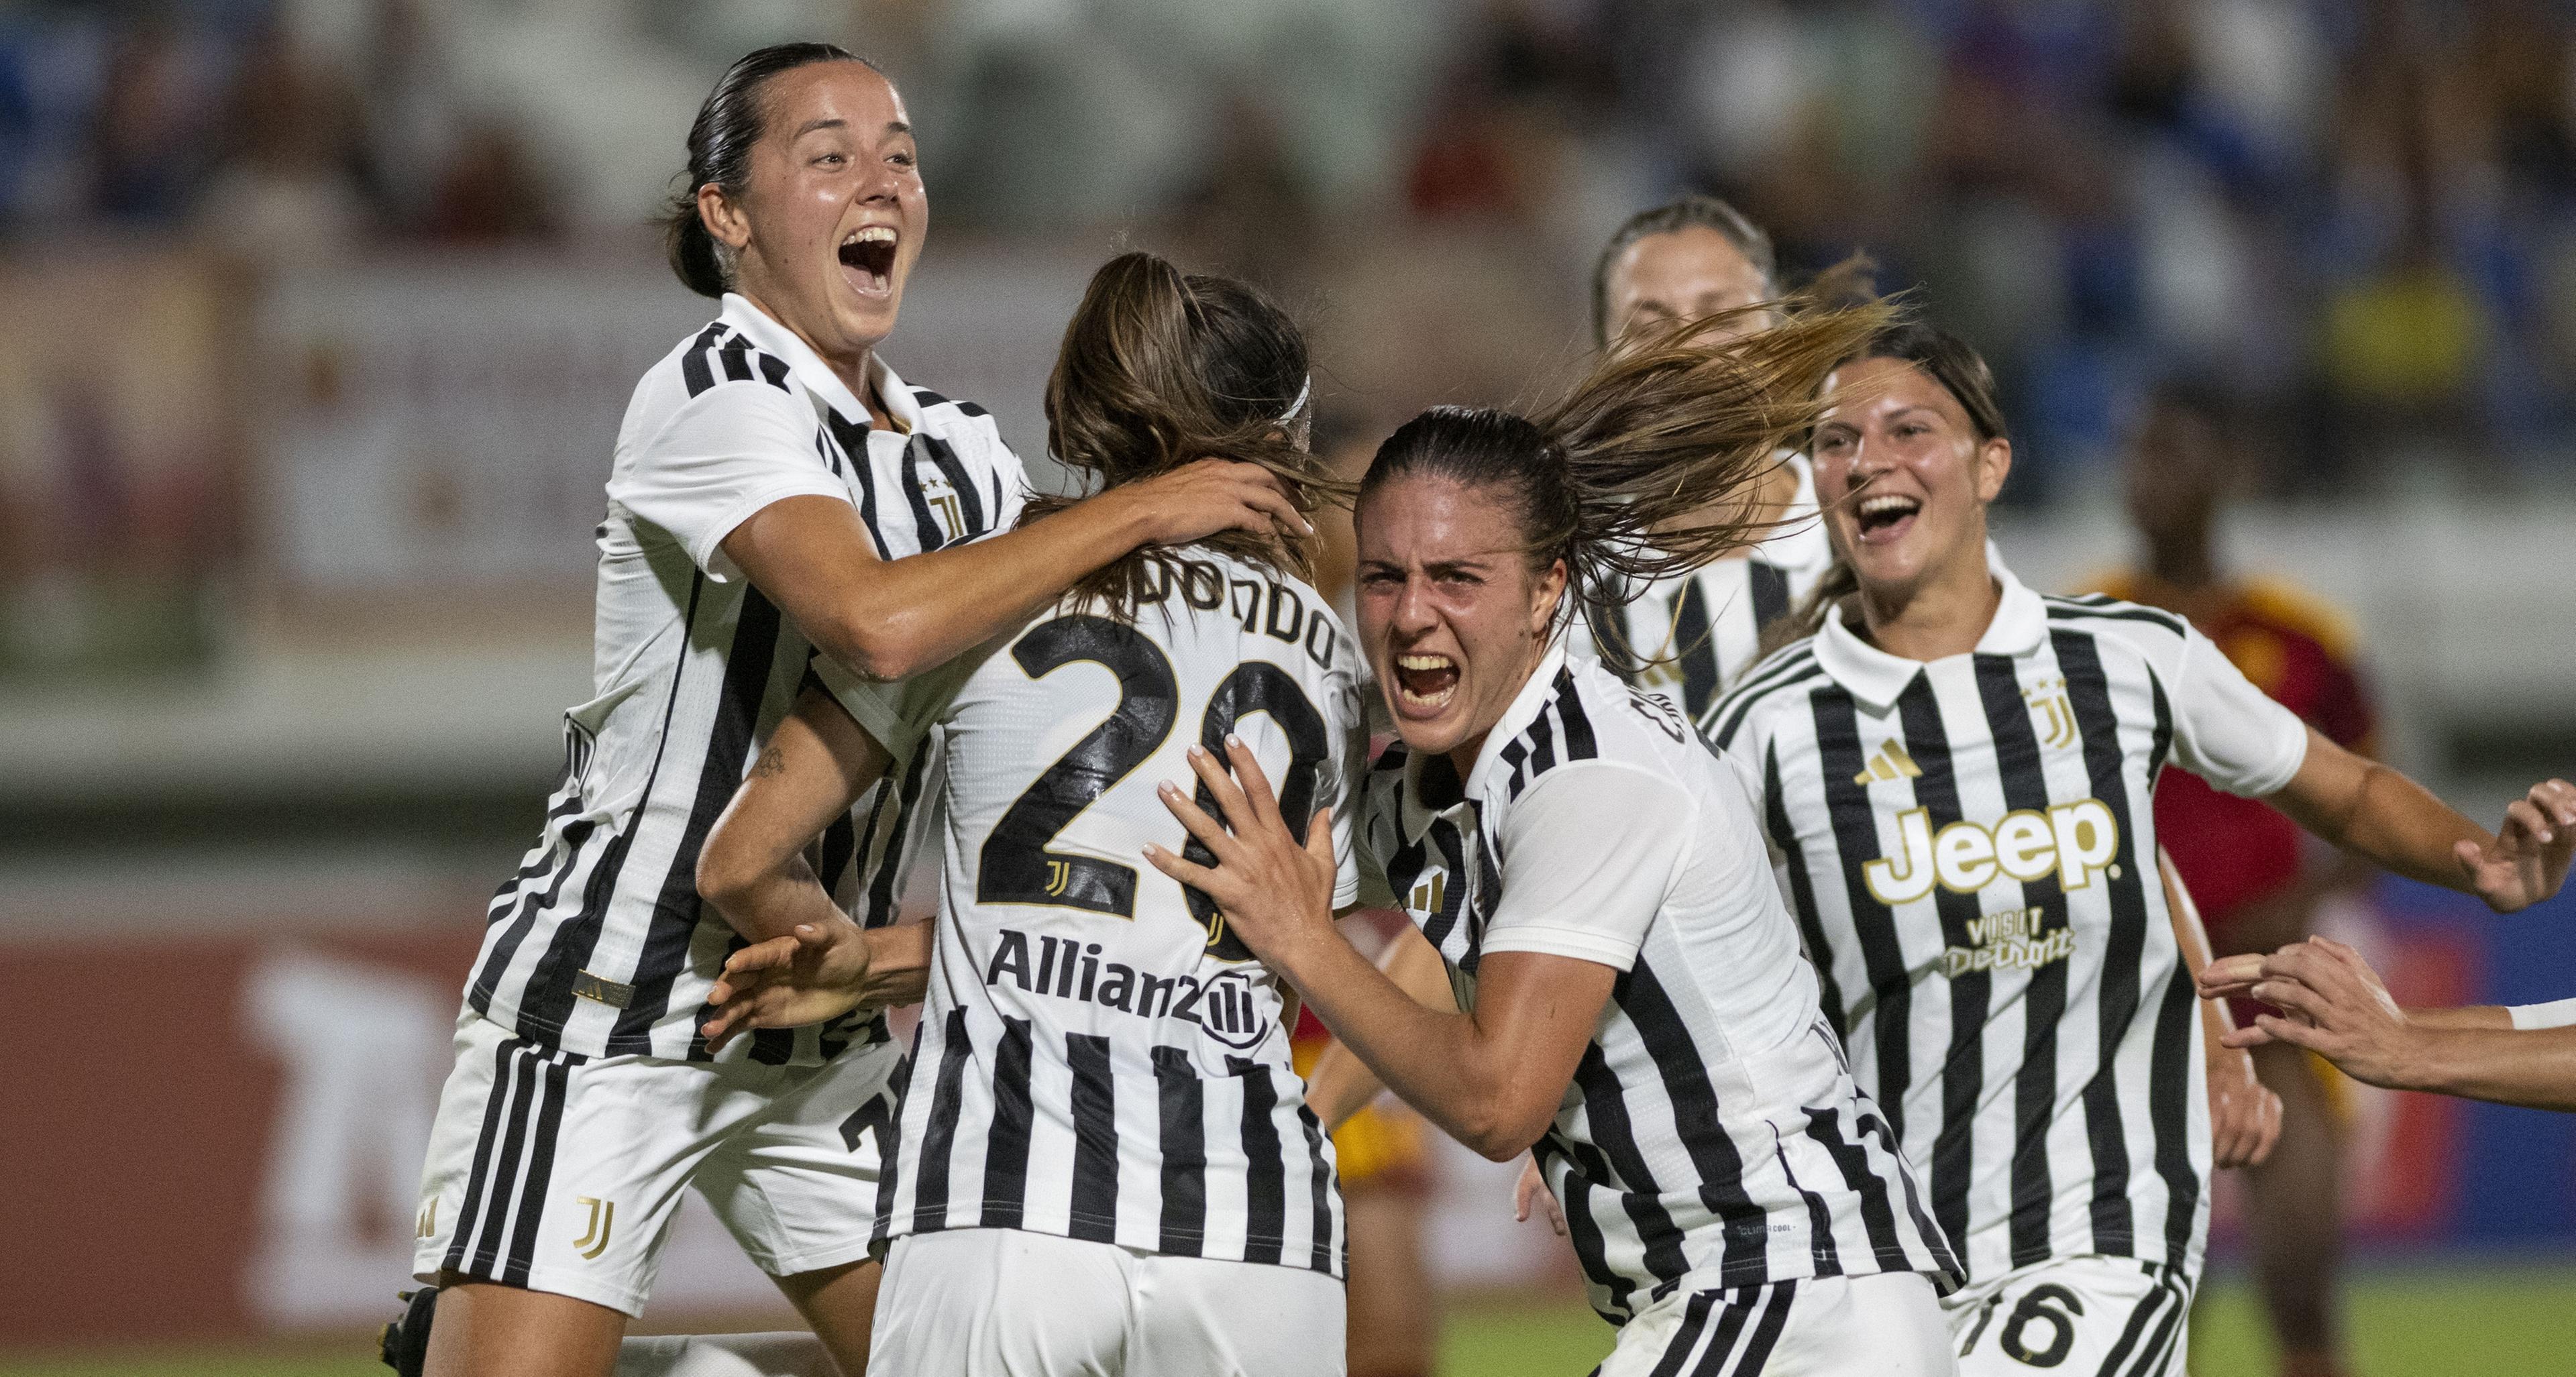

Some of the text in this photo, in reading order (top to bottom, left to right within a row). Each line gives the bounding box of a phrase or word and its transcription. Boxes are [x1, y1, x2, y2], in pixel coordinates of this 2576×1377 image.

[1139, 554, 1336, 671] DONDO
[976, 614, 1328, 962] 20
[1863, 797, 2118, 905] Jeep
[1944, 926, 2077, 979] Detroit
[1966, 907, 2043, 946] VISIT
[987, 929, 1203, 1026] Allianz
[1958, 1282, 2086, 1368] 16
